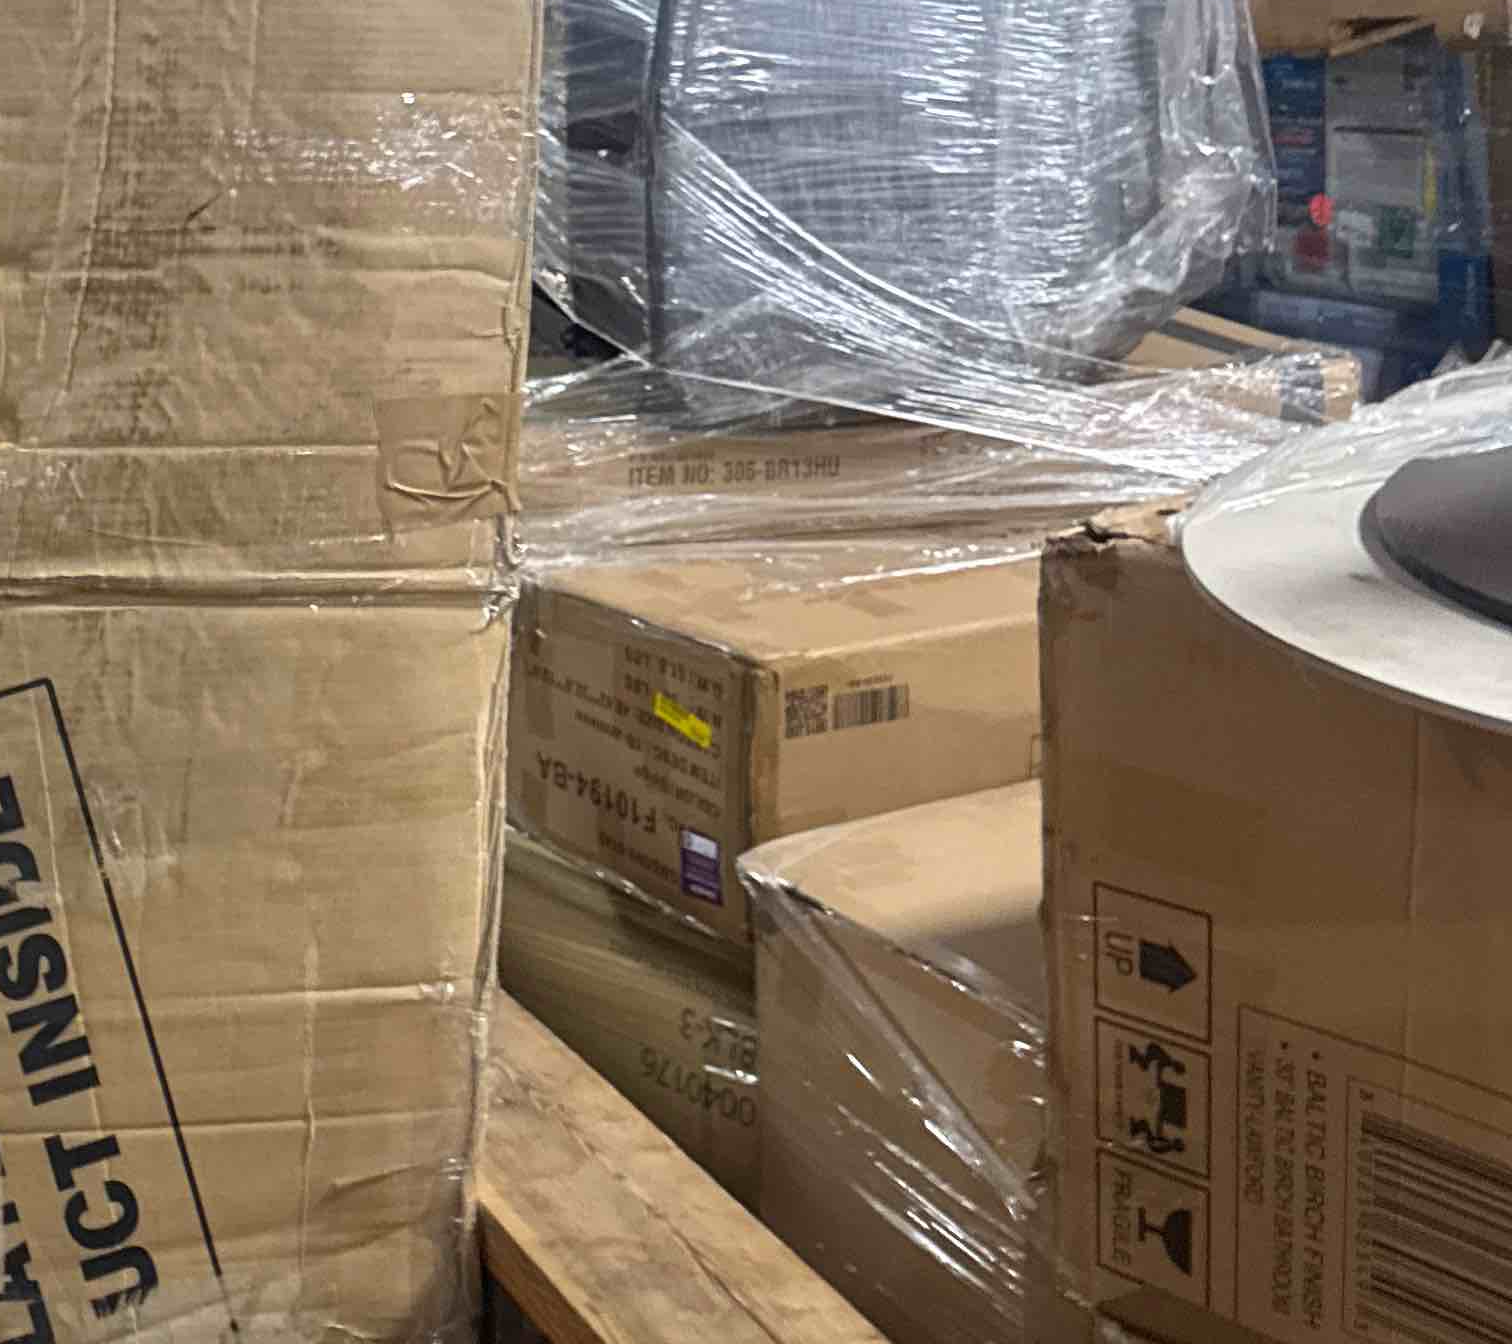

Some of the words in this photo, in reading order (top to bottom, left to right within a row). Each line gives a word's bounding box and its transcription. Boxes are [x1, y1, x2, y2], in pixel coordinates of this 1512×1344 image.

[629, 464, 675, 487] ITEM
[536, 751, 658, 837] F10194-BA
[1104, 929, 1134, 977] UP
[1305, 1069, 1328, 1159] BALTIC
[1111, 1167, 1133, 1266] FRAGILE
[1305, 1164, 1327, 1243] BIRCH
[1302, 1245, 1326, 1333] FINISH
